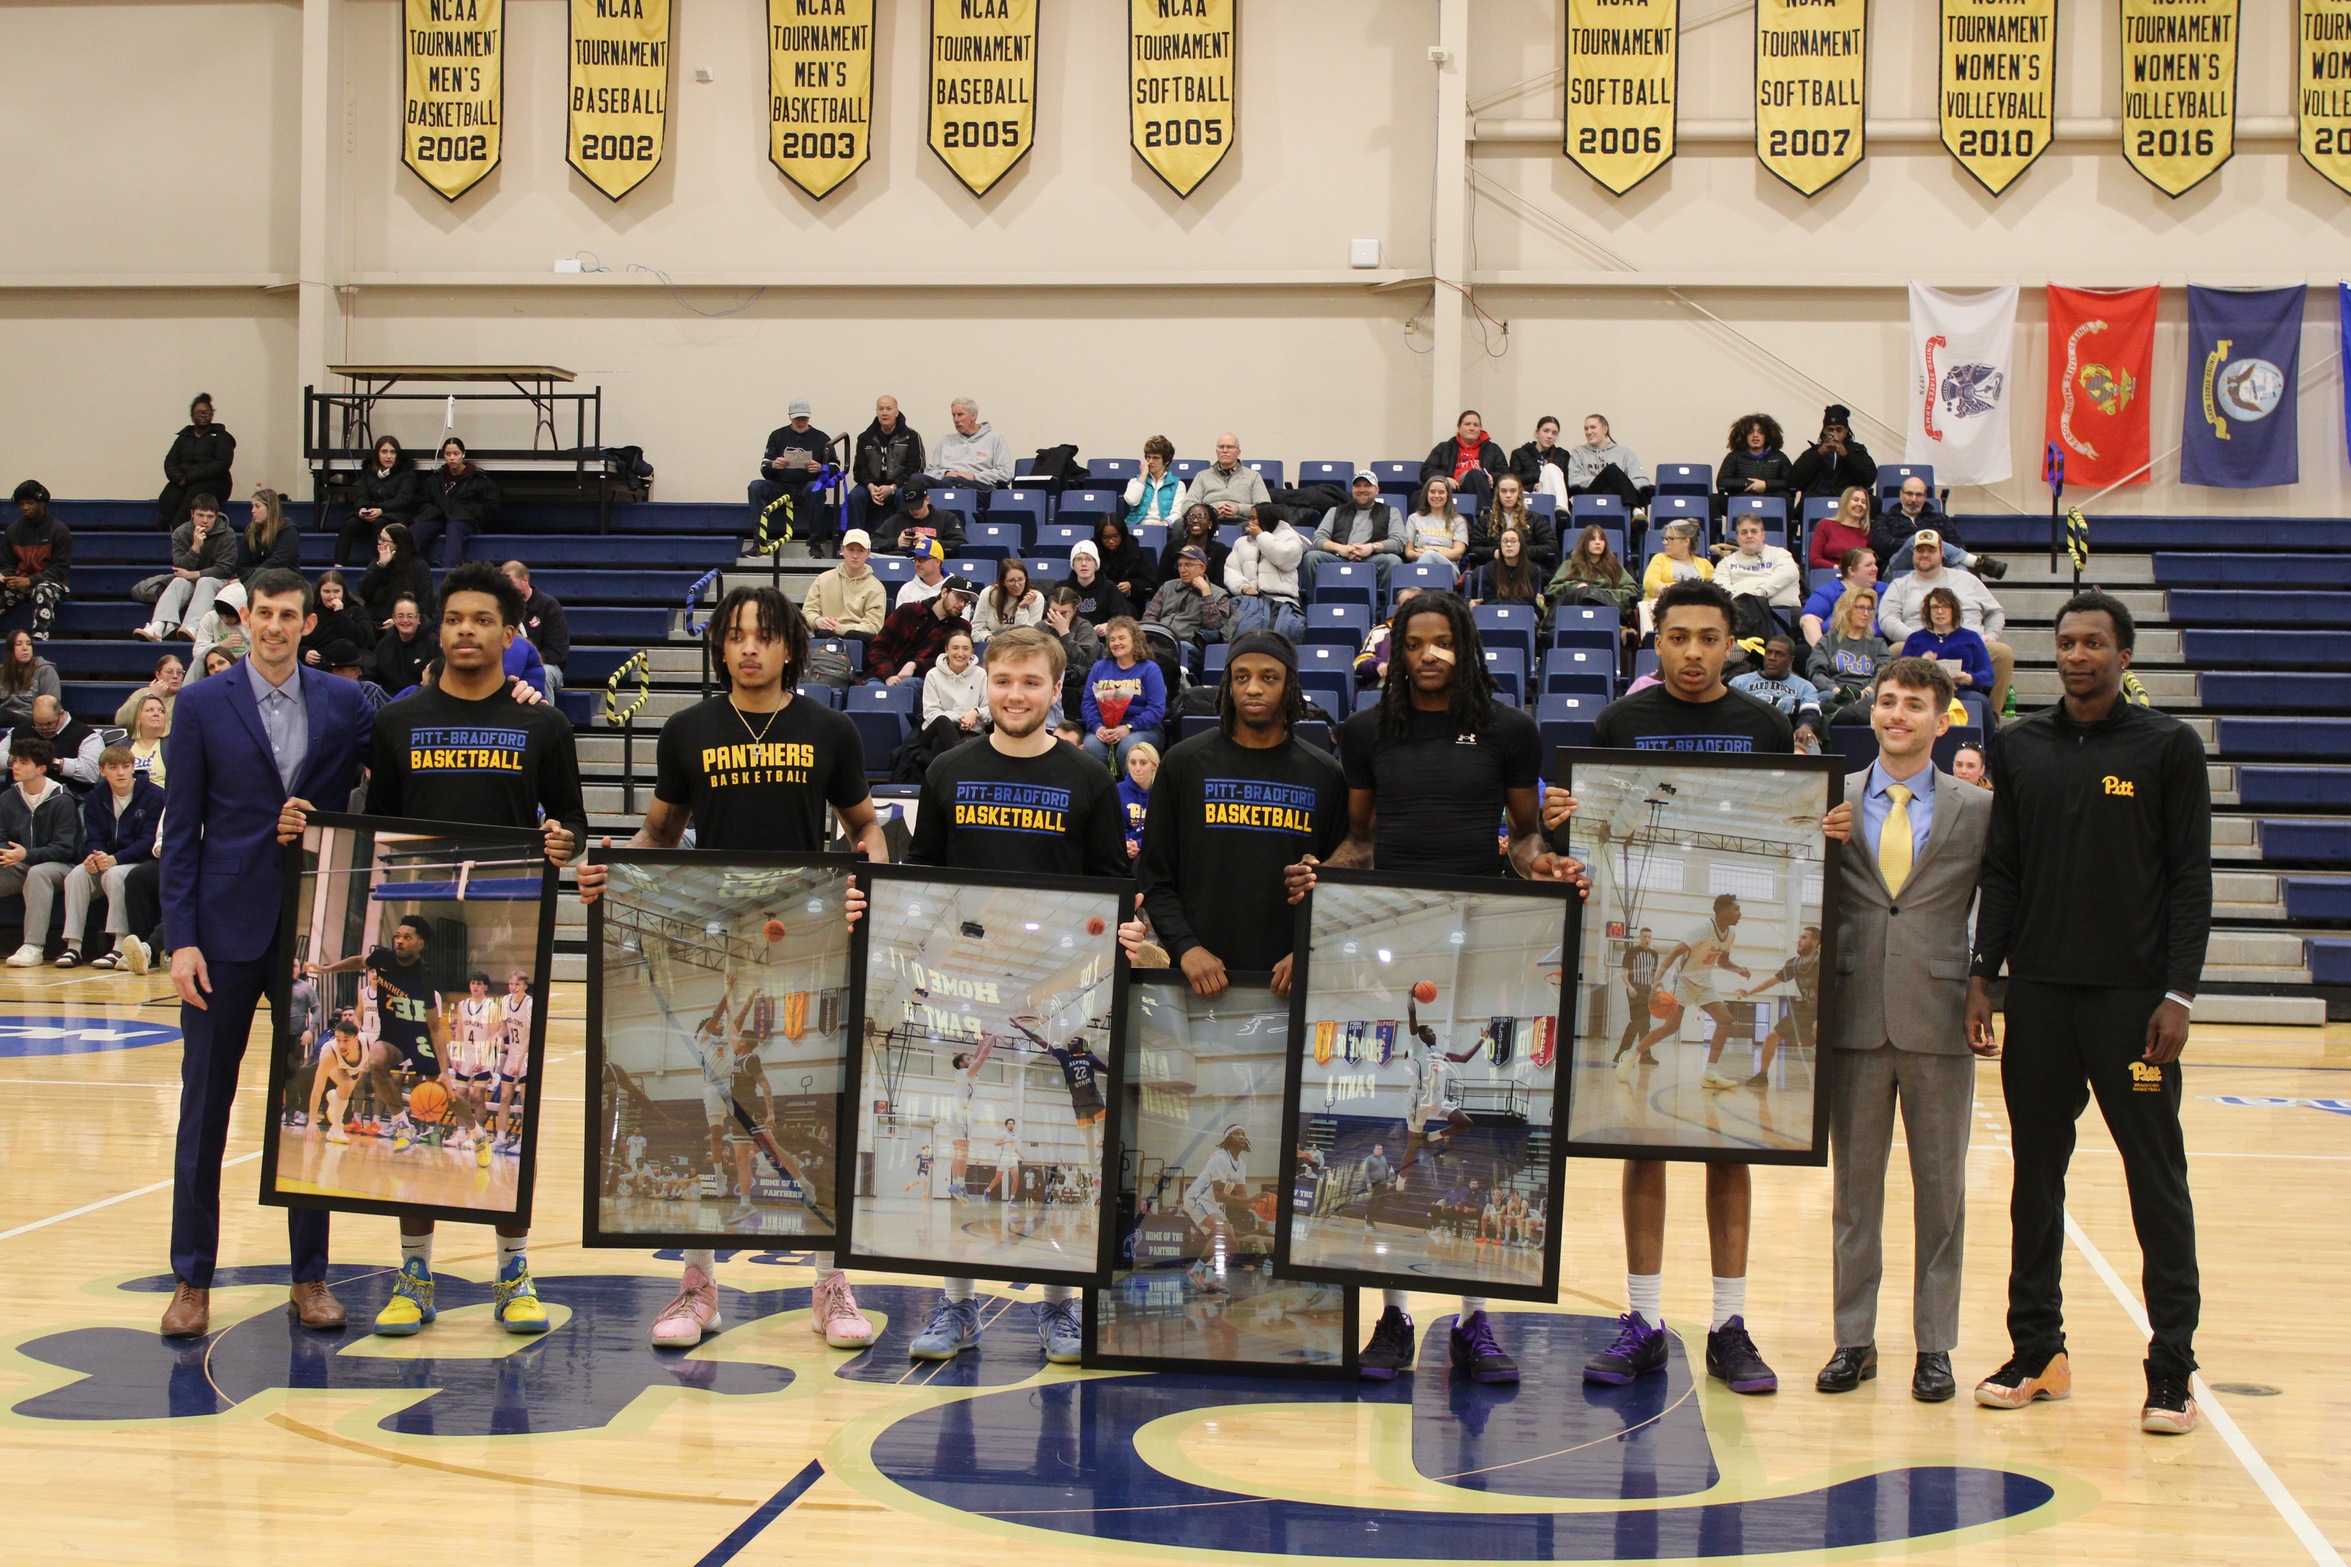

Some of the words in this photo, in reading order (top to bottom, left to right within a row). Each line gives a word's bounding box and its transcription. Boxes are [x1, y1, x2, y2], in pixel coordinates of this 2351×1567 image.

[431, 0, 477, 21] NCAA
[596, 0, 643, 19] NCAA
[961, 0, 1009, 19] NCAA
[774, 25, 868, 51] TOURNAMENT
[1572, 28, 1672, 55] TOURNAMENT
[1947, 15, 2048, 42] TOURNAMENT
[2126, 15, 2232, 43] TOURNAMENT
[410, 29, 497, 57] TOURNAMENT
[575, 40, 666, 67] TOURNAMENT
[936, 35, 1031, 61] TOURNAMENT
[1135, 32, 1230, 61] TOURNAMENT
[1762, 28, 1861, 56] TOURNAMENT
[429, 66, 480, 92] MEN'S
[794, 61, 847, 87] MEN'S
[1955, 54, 2040, 81] WOMEN'S
[2135, 54, 2220, 82] WOMEN'S
[572, 86, 664, 114] BASEBALL
[936, 78, 1029, 104] BASEBALL
[1137, 76, 1229, 104] SOFTBALL
[1571, 77, 1670, 105] SOFTBALL
[1761, 79, 1860, 106] SOFTBALL
[407, 100, 497, 127] BASKETBALL
[773, 96, 866, 123] BASKETBALL
[1947, 91, 2047, 119] VOLLEYBALL
[2126, 91, 2228, 119] VOLLEYBALL
[783, 133, 854, 159] 2003
[944, 121, 1018, 147] 2005
[1145, 119, 1222, 147] 2005
[1580, 127, 1661, 154] 2006
[1770, 129, 1850, 156] 2007
[1959, 129, 2033, 157] 2010
[2137, 129, 2214, 156] 2016
[418, 135, 487, 161] 2002
[582, 135, 653, 160] 2002
[1928, 372, 1936, 403] STATES
[1749, 681, 1768, 692] HARD
[411, 731, 526, 747] PITT-BRADFORD
[411, 749, 522, 771] BASKETBALL
[702, 743, 814, 772] PANTHERS
[710, 770, 807, 788] BASKETBALL
[2101, 775, 2134, 797] Pitt
[956, 786, 1069, 808] PITT-BRADFORD
[1205, 783, 1315, 807] PITT-BRADFORD
[955, 804, 1066, 832] BASKETBALL
[1205, 803, 1312, 832] BASKETBALL
[468, 1030, 475, 1045] 4
[1073, 1066, 1087, 1080] 22
[2128, 1061, 2162, 1081] Pitt
[760, 1179, 780, 1187] HOME
[763, 1189, 803, 1198] PANTHERS
[1145, 1231, 1162, 1241] HOME
[1163, 1232, 1171, 1241] OF
[1172, 1233, 1184, 1242] THE
[1149, 1246, 1180, 1256] PANTHERS
